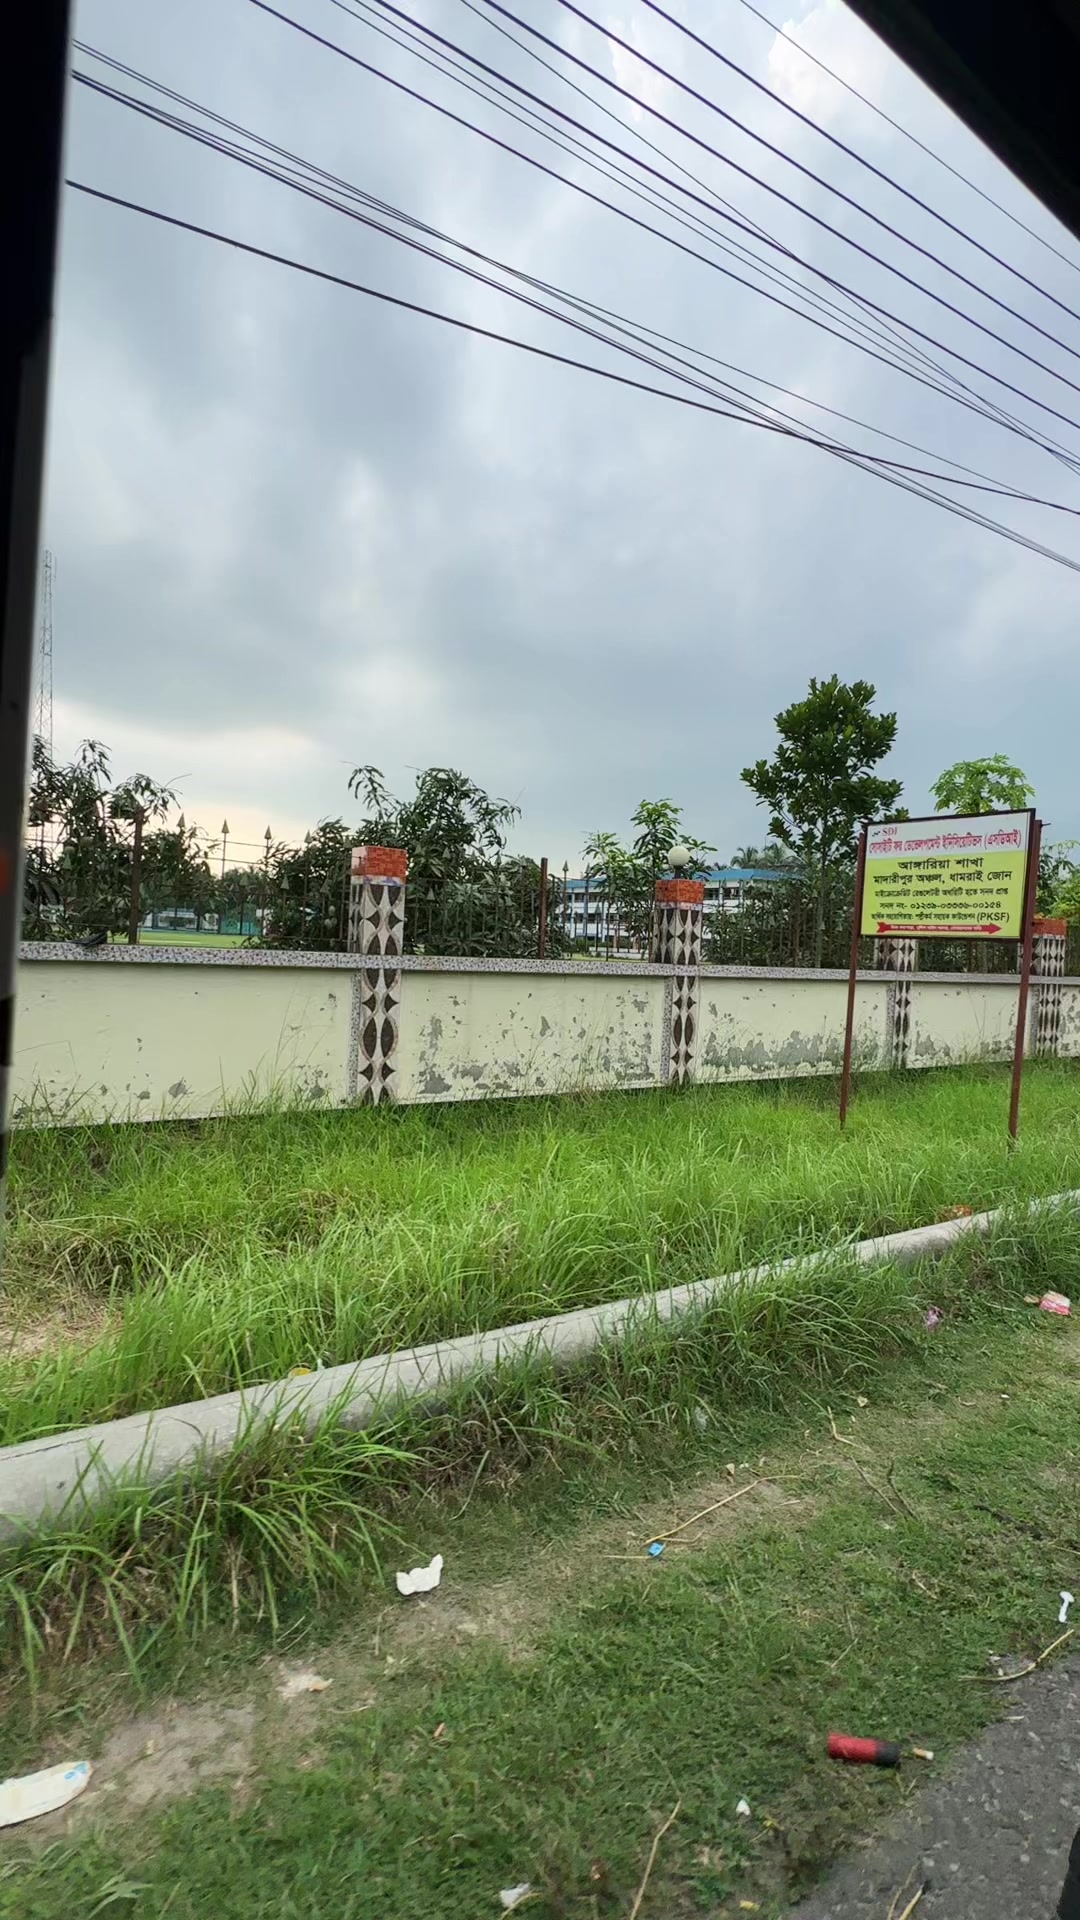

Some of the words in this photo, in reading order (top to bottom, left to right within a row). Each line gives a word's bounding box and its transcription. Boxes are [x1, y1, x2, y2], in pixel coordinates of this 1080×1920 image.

[883, 826, 898, 837] SDI
[897, 857, 951, 870] আঙ্গারিয়া
[954, 857, 984, 868] শাখা
[873, 872, 913, 885] মাদারীপুর
[950, 869, 984, 882] ধামরাই
[987, 871, 1012, 881] জোন
[976, 911, 1010, 923] (PKSF)
